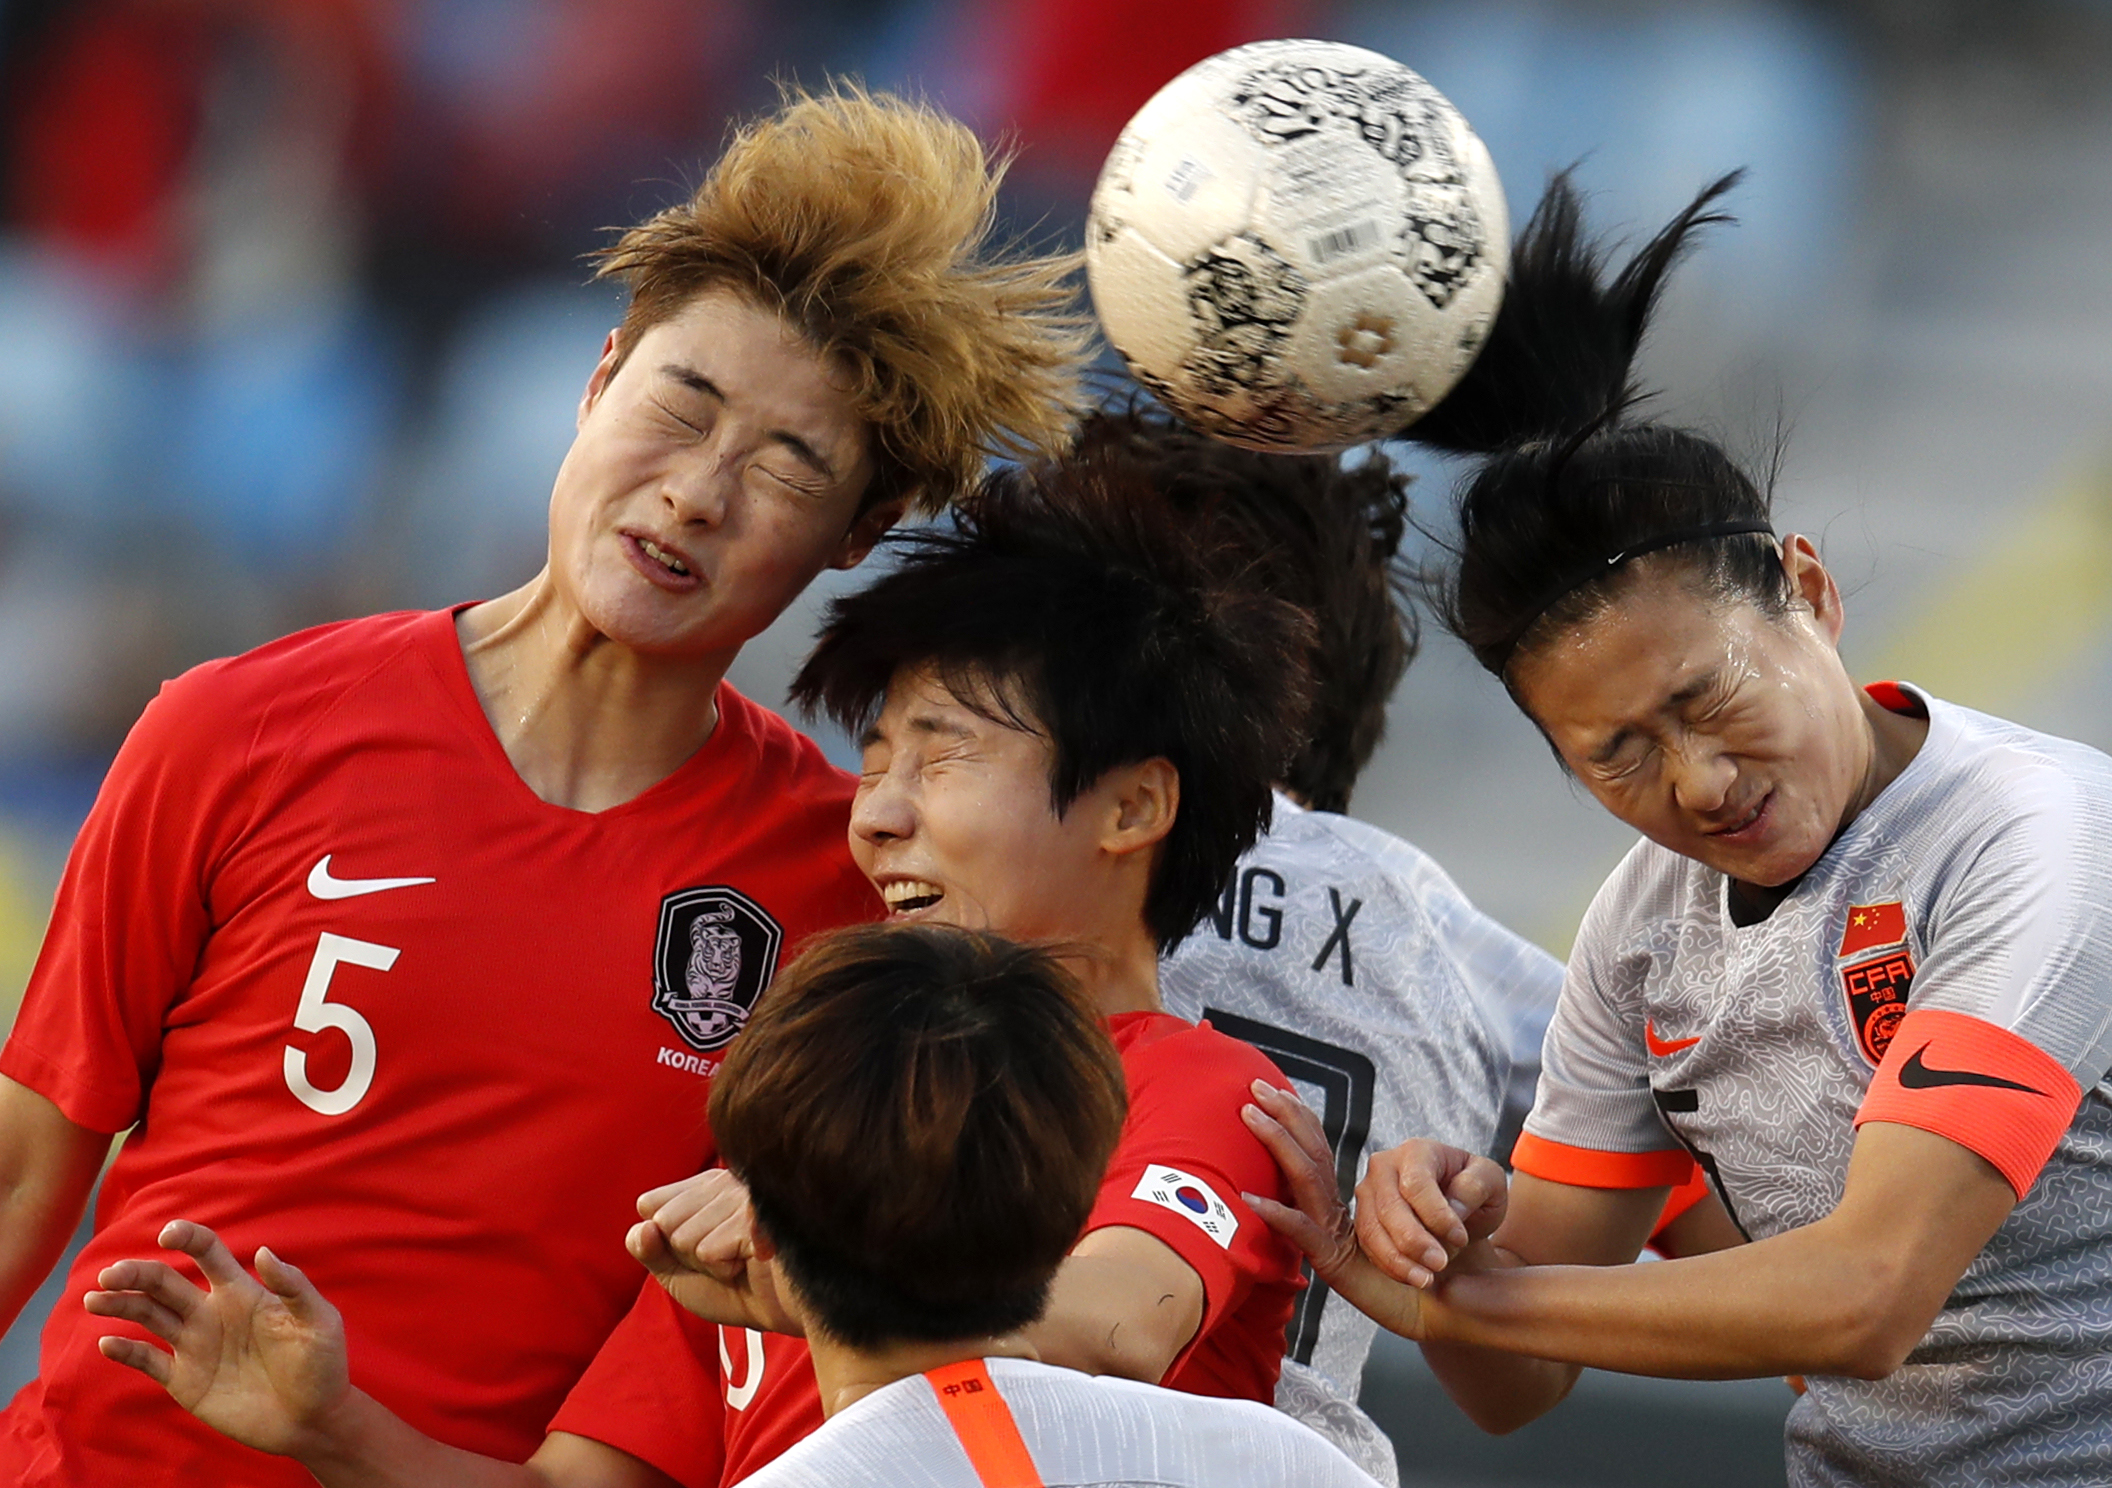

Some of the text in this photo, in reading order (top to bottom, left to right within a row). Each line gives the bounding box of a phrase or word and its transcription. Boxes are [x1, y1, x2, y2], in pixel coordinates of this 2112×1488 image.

[1211, 864, 1363, 987] NG X
[1848, 961, 1910, 996] CFA
[283, 931, 401, 1116] 5
[942, 1378, 984, 1398] 中国
